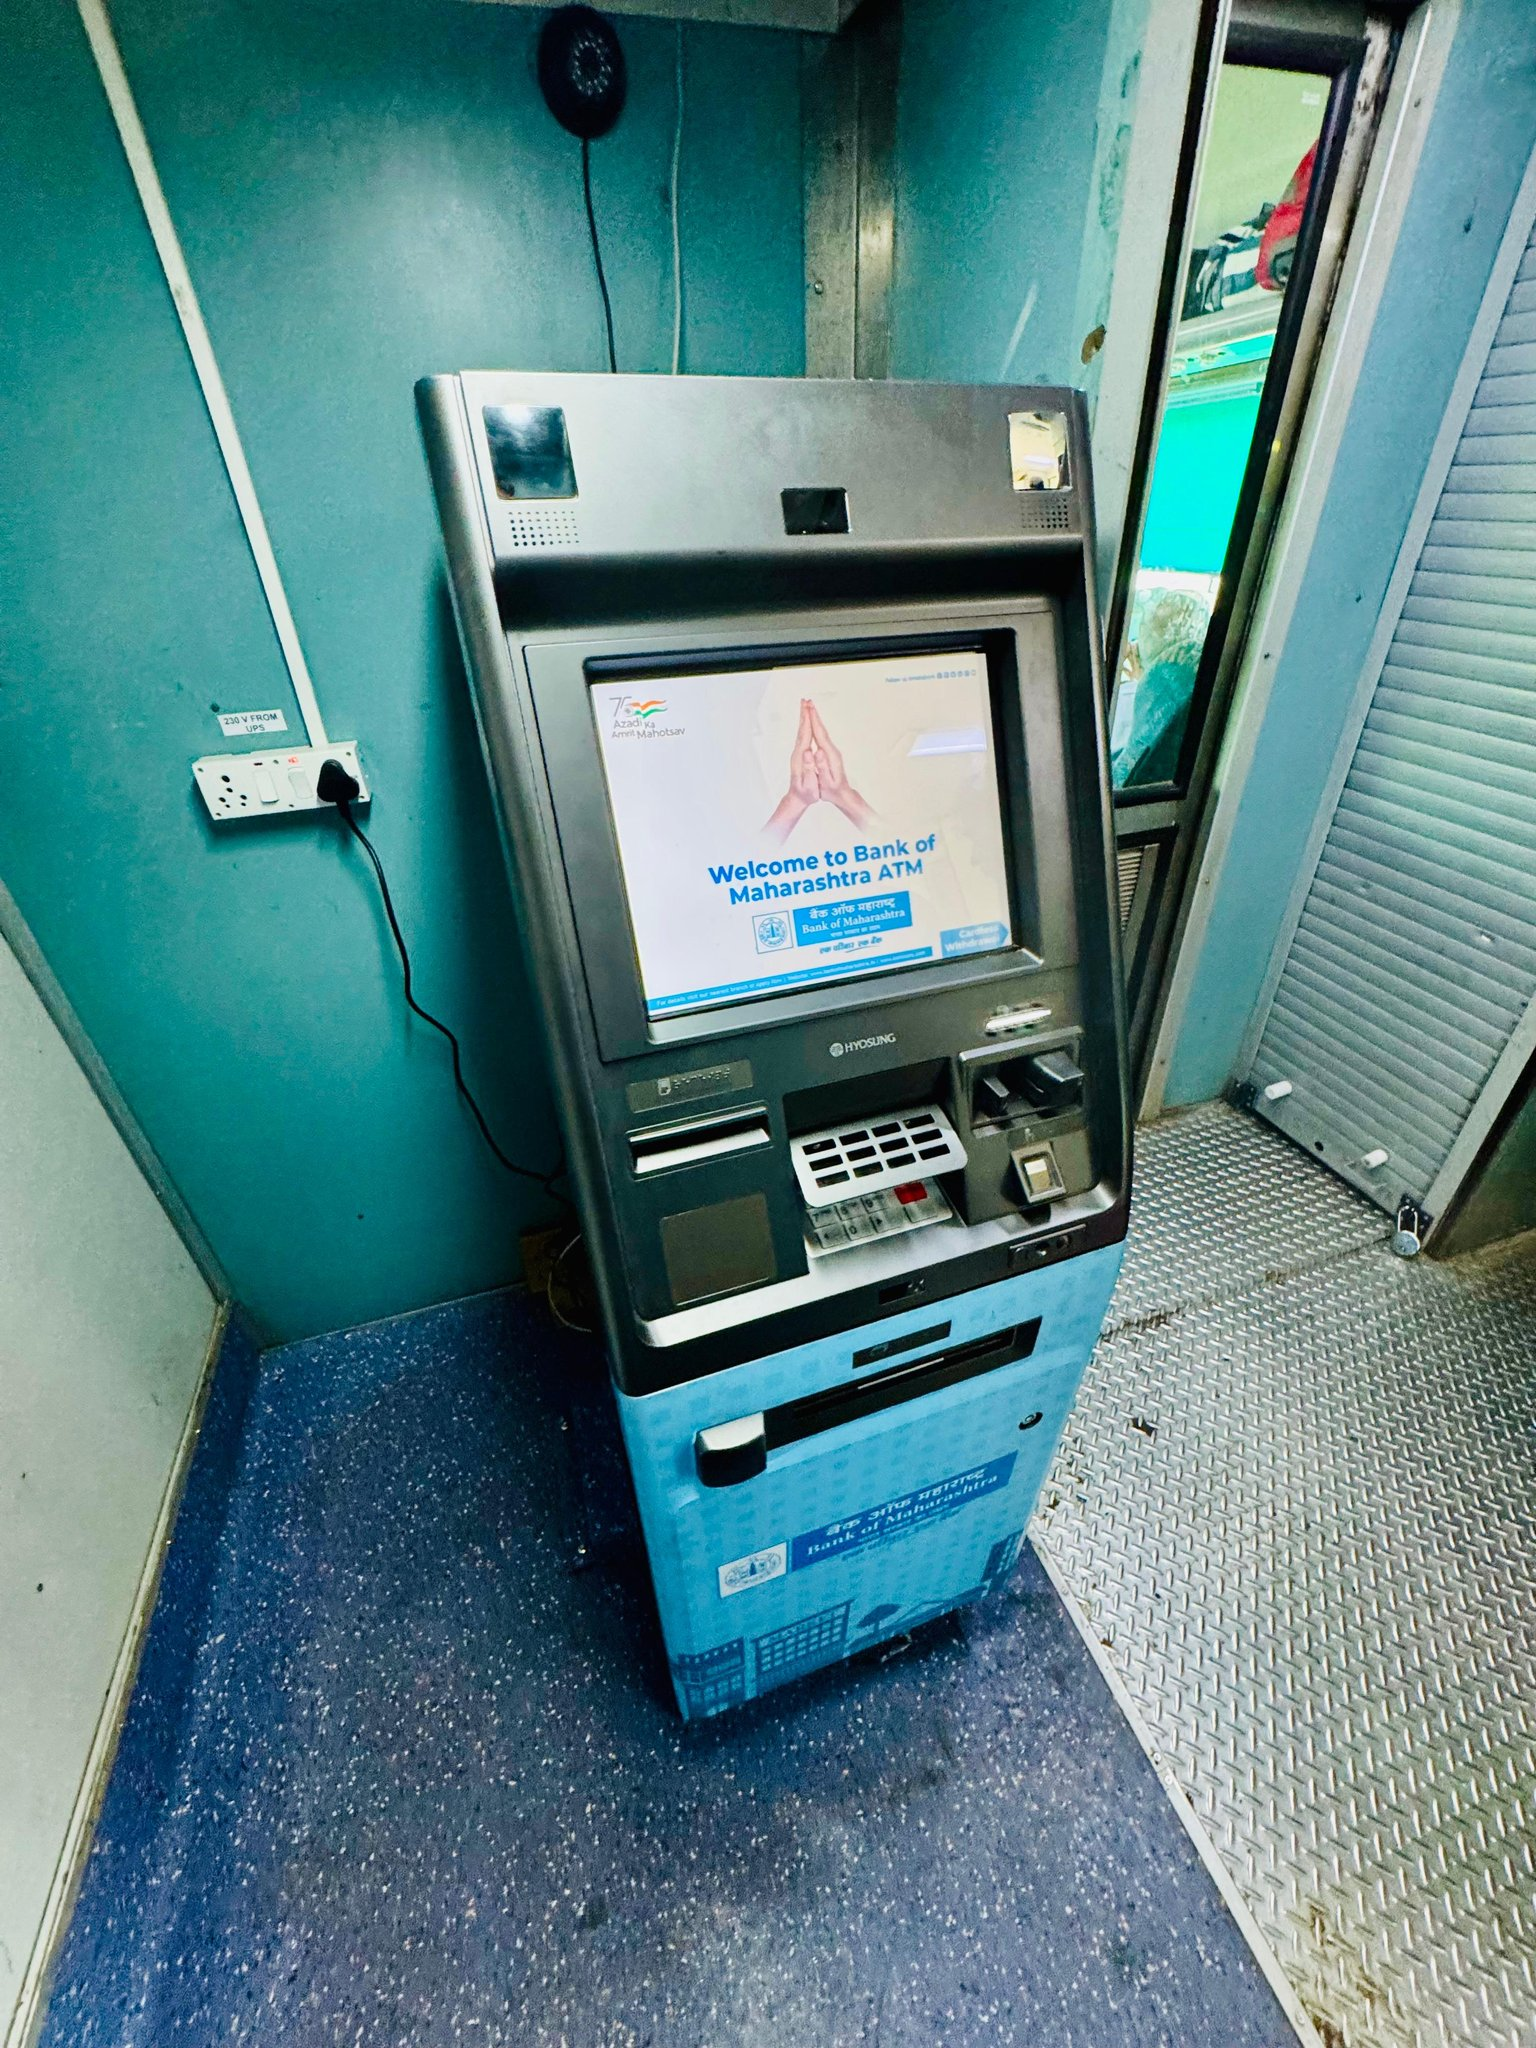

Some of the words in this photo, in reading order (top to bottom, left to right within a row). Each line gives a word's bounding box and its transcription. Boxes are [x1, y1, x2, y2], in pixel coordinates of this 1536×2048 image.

[223, 716, 239, 725] 230
[250, 712, 278, 723] FROM
[245, 724, 265, 733] UPS
[613, 717, 643, 730] Azadi
[612, 729, 636, 738] Amrit
[636, 727, 686, 739] Mahotsav
[708, 854, 819, 885] Welcome
[824, 850, 848, 867] to
[854, 839, 911, 862] Bank
[915, 833, 936, 853] of
[728, 869, 872, 905] Maharashtra
[877, 858, 923, 882] ATM
[802, 921, 828, 934] Bank
[830, 918, 841, 929] of
[843, 909, 906, 928] Maharashtra
[844, 1033, 897, 1053] HYOSUNG
[807, 1531, 855, 1555] Bank
[860, 1518, 879, 1535] of
[885, 1475, 998, 1526] Maharashtra
